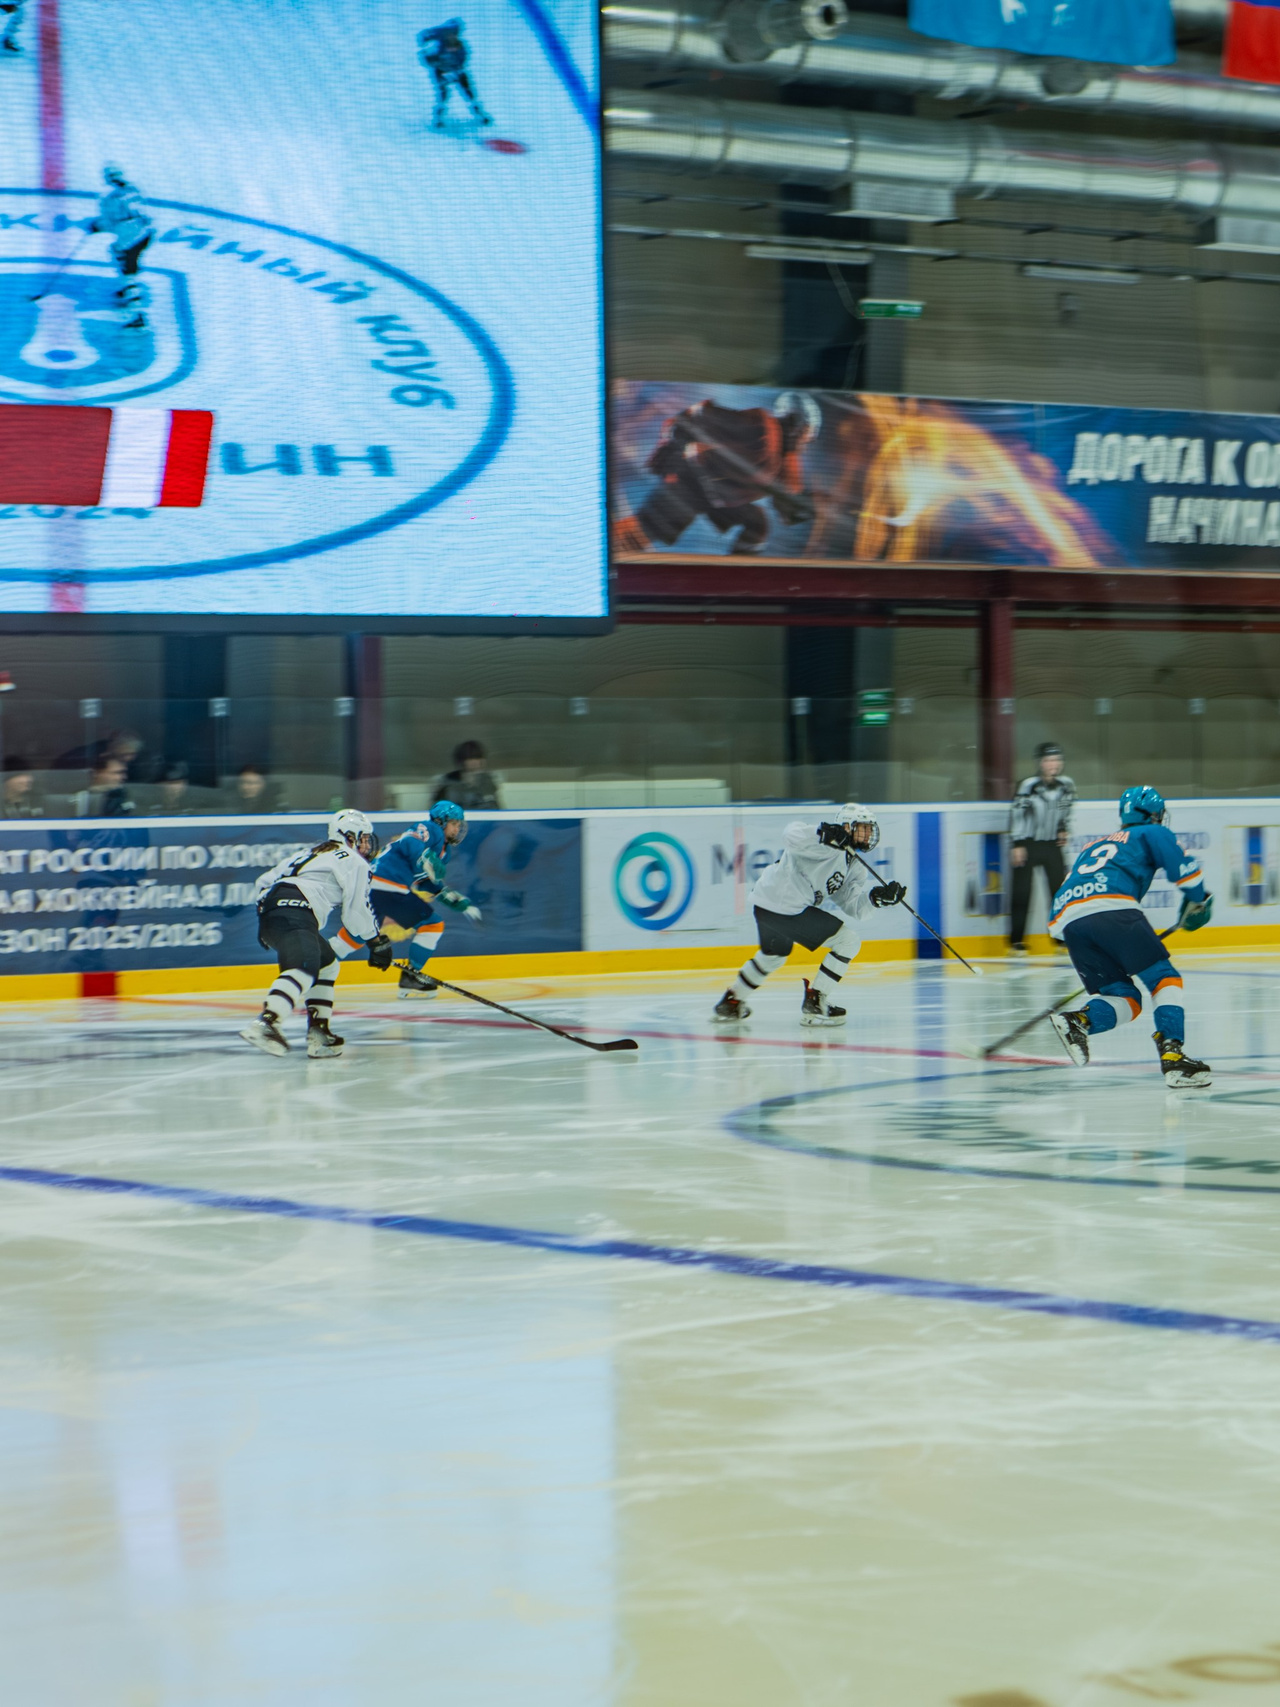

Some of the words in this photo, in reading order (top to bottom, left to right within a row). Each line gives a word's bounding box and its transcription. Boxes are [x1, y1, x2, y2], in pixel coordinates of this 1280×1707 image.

[355, 314, 456, 410] КЛУБ
[1067, 432, 1206, 486] ДОРОГА
[1210, 441, 1243, 486] К
[29, 846, 158, 873] РОССИИ
[160, 844, 208, 869] ПО
[207, 843, 318, 869] ХОКК
[1077, 843, 1118, 875] 3
[34, 879, 222, 913] ХОККЕЙНАЯ
[67, 921, 223, 951] 2025/2026
